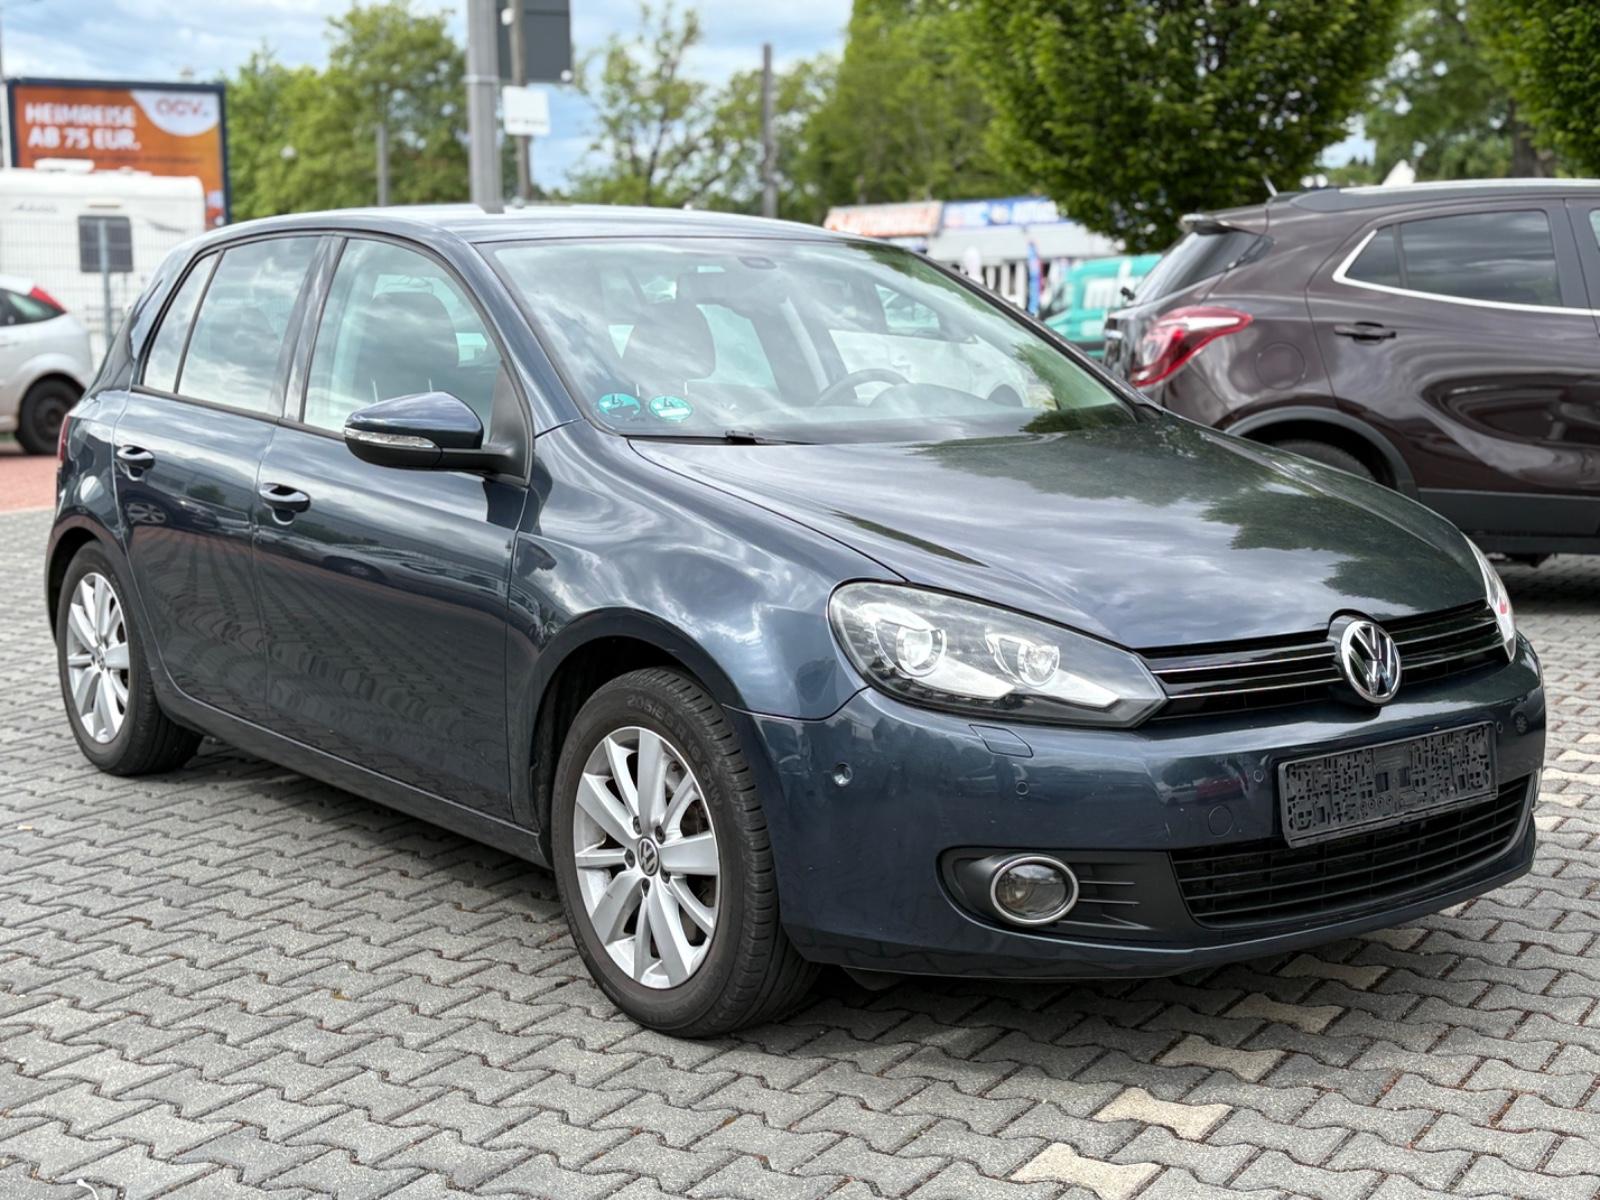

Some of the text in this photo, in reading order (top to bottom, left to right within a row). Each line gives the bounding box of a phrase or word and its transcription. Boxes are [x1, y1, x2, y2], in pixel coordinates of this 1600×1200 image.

[24, 101, 137, 129] HEIMREISE
[27, 126, 142, 151] AB 75 EUR.
